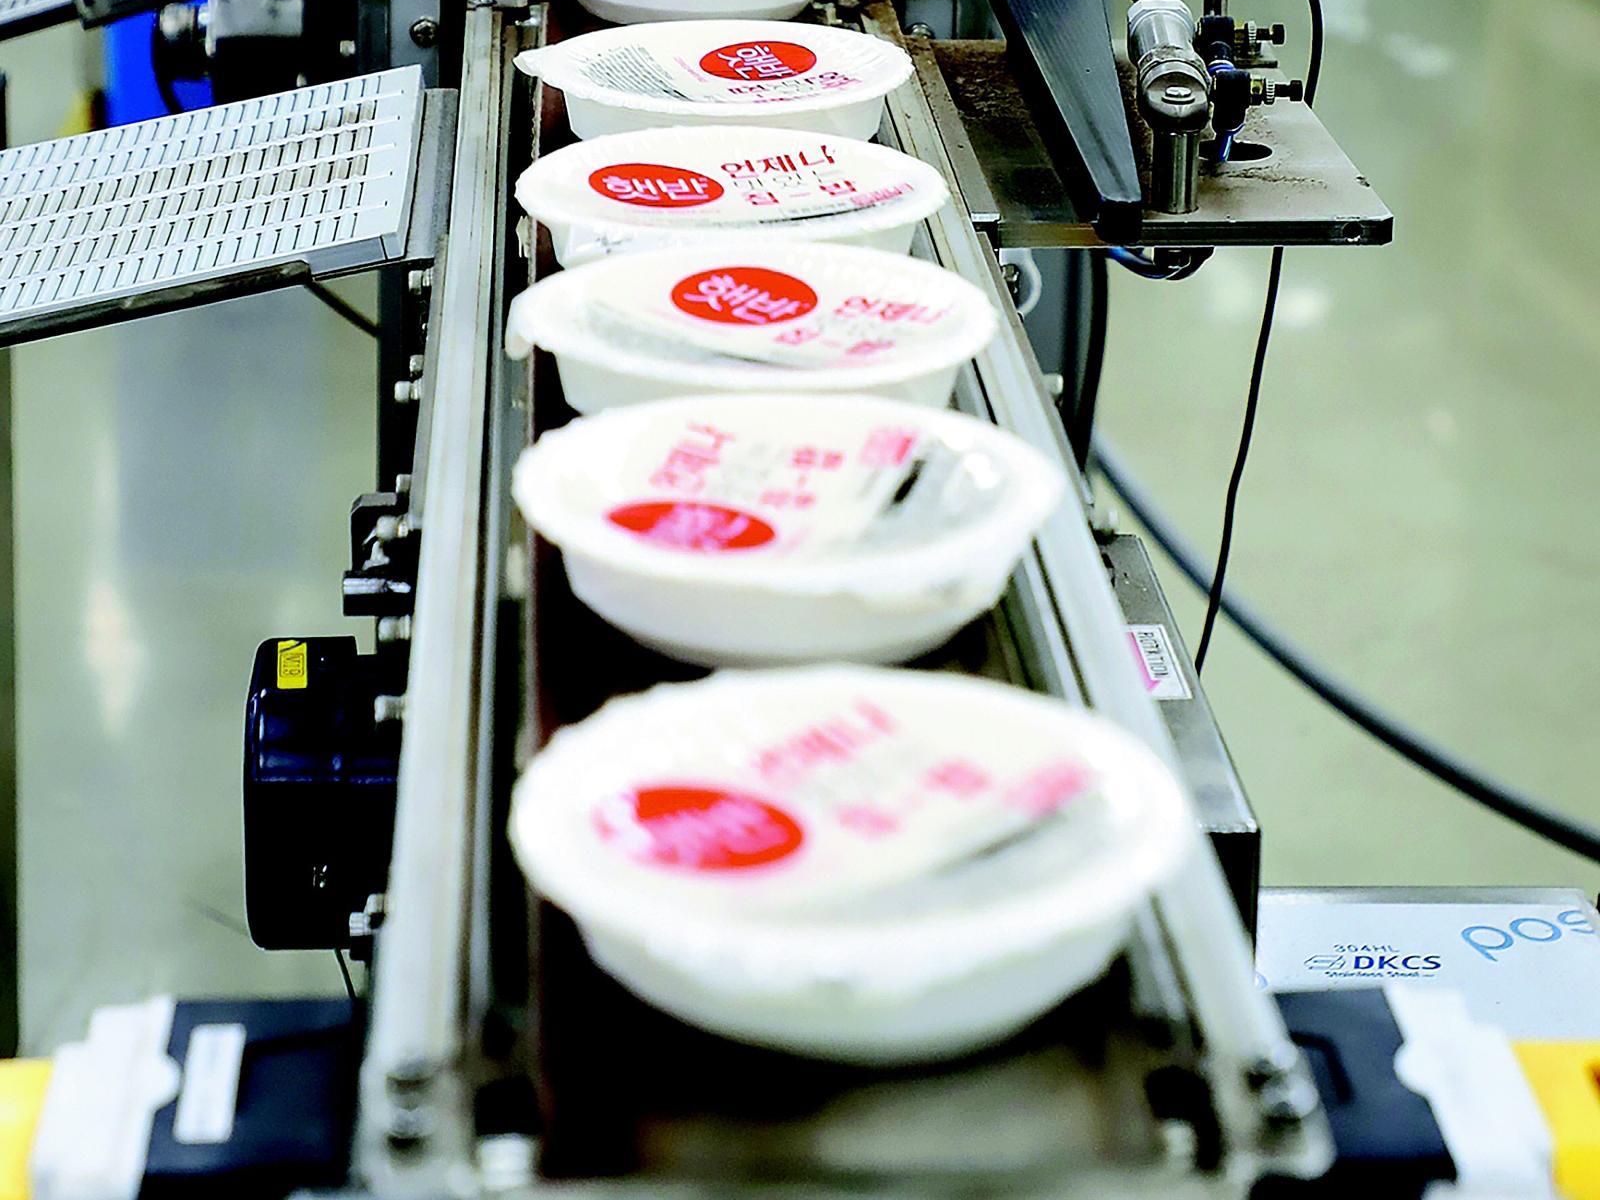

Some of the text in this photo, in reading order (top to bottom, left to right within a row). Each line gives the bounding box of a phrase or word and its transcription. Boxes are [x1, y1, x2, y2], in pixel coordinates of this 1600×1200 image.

[717, 45, 796, 80] 햇반
[721, 144, 836, 179] 언제나
[602, 175, 709, 201] 햇반
[684, 274, 809, 325] 햇반
[1353, 955, 1442, 970] DKCS
